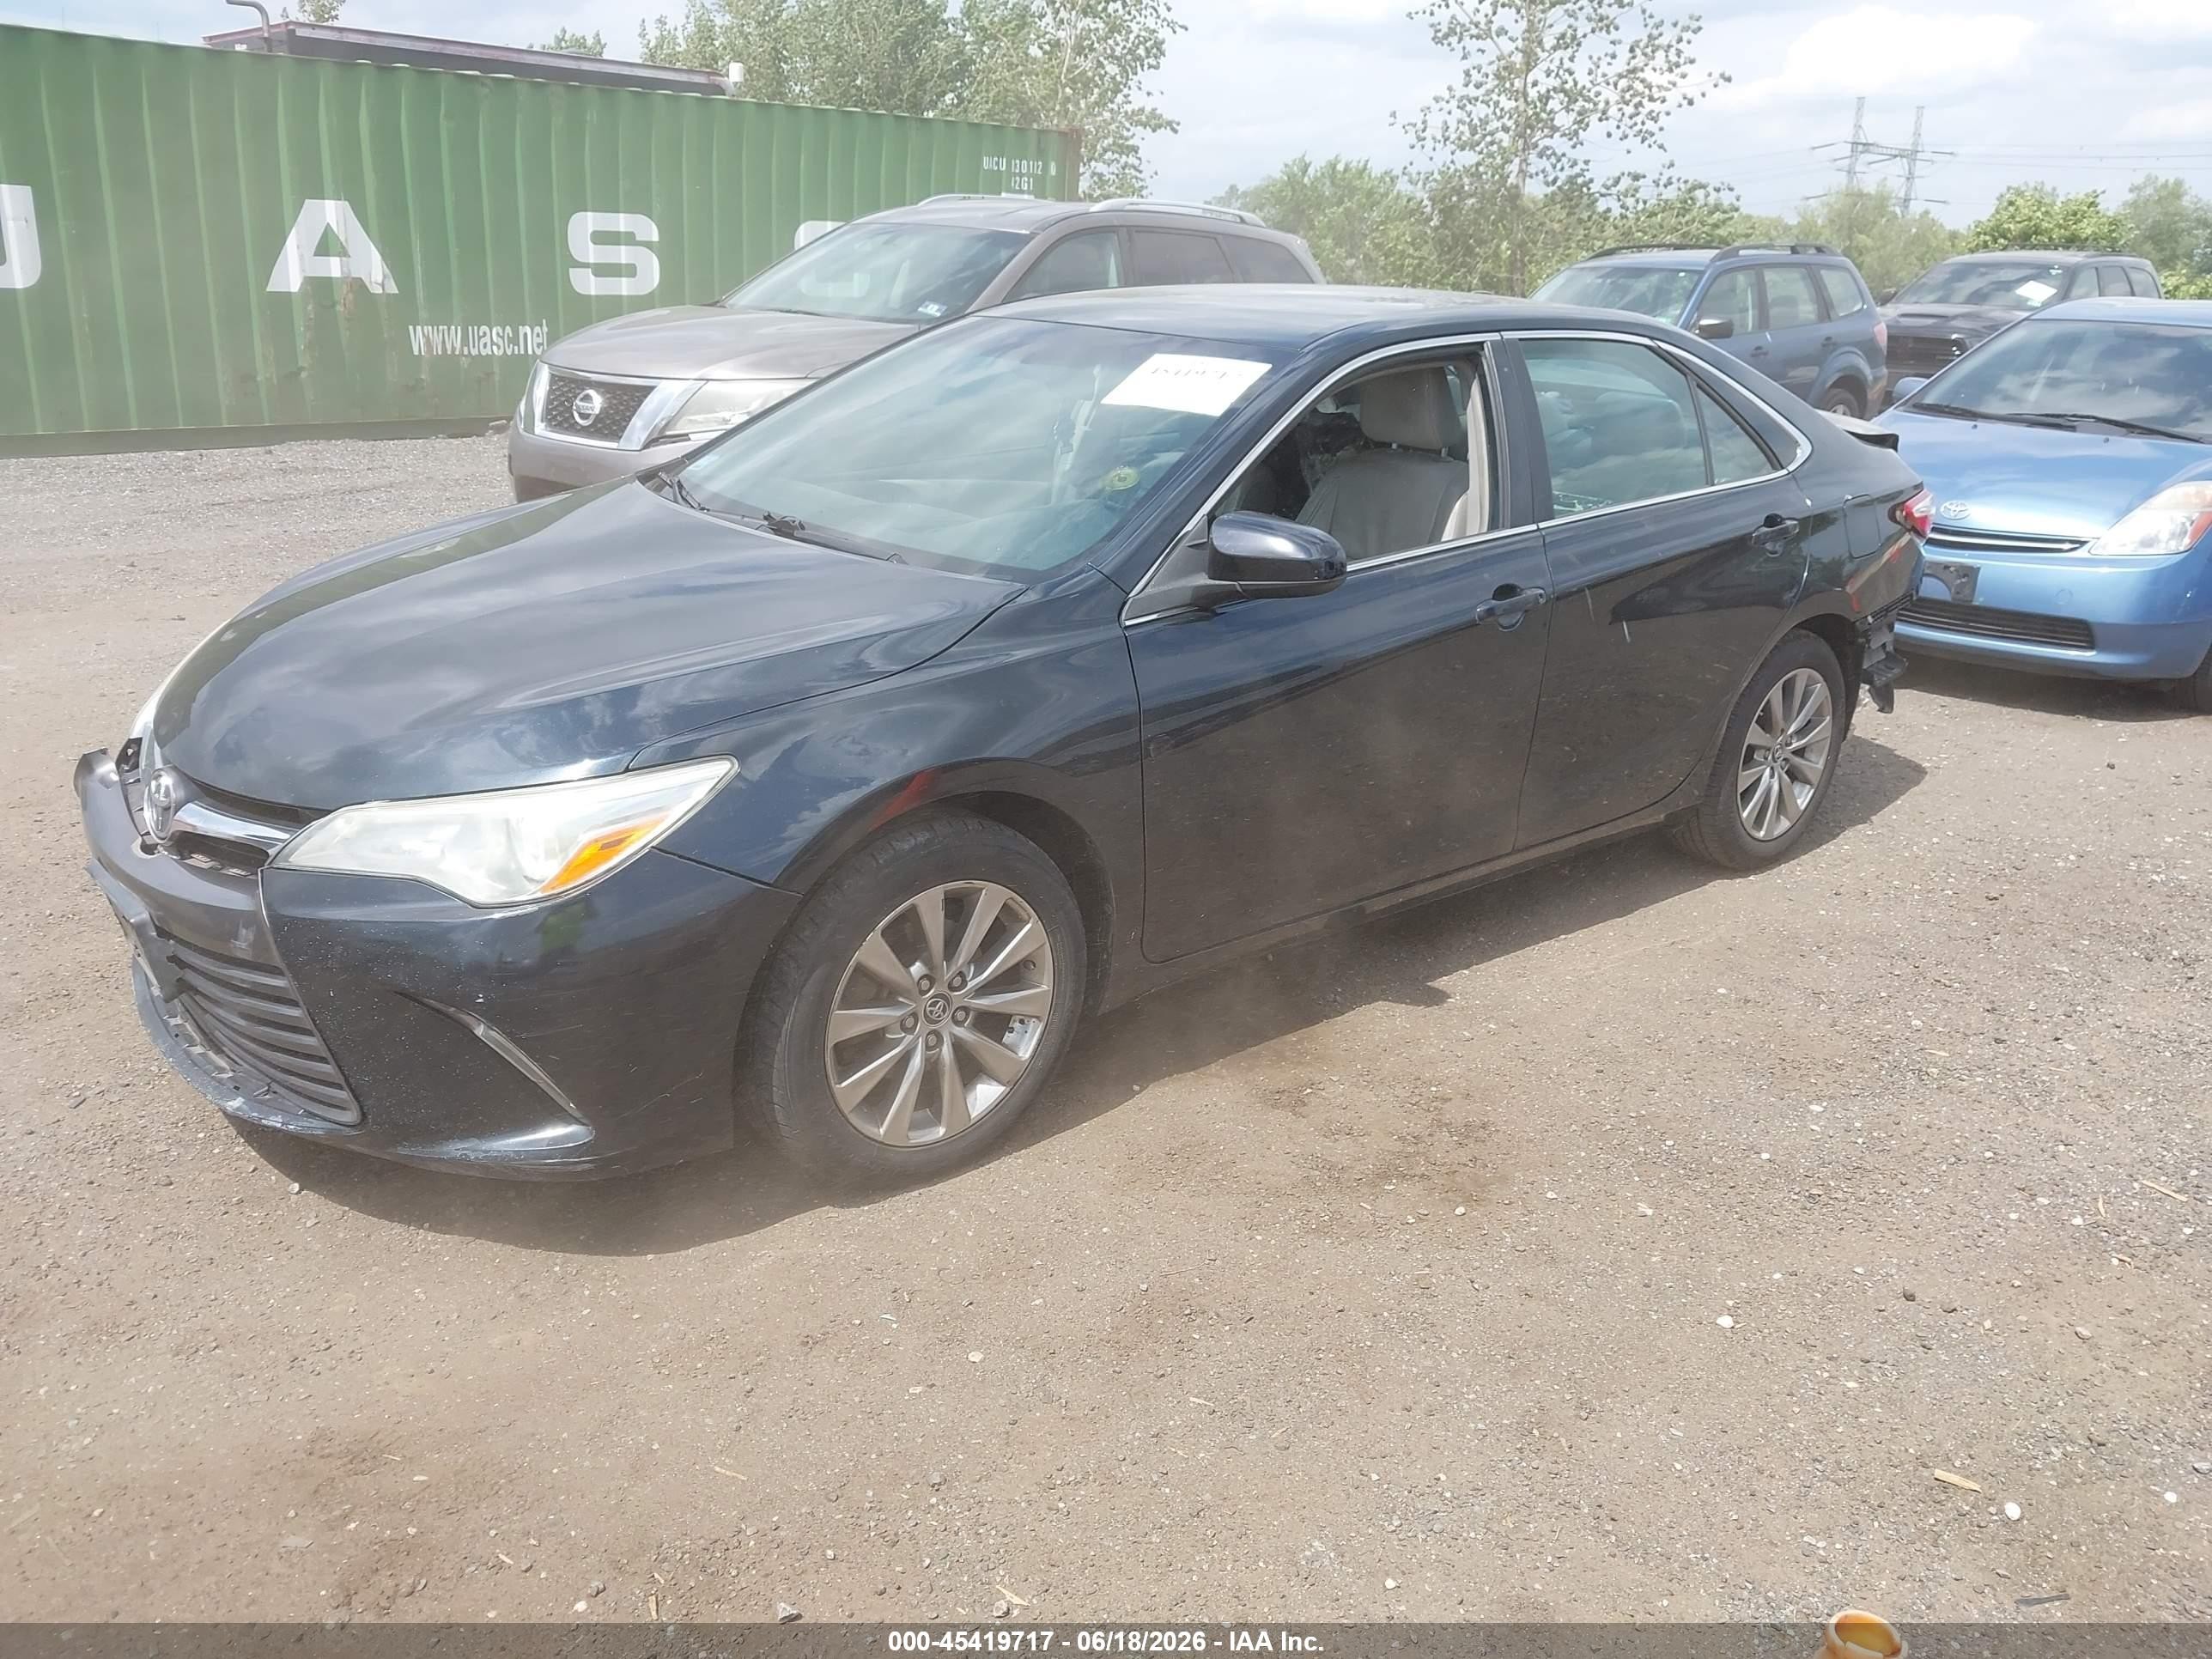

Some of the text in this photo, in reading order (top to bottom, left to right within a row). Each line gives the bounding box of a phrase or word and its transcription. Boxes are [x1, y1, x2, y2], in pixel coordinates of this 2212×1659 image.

[266, 199, 398, 294] A
[568, 211, 659, 295] S
[408, 319, 548, 356] www.uasc.net
